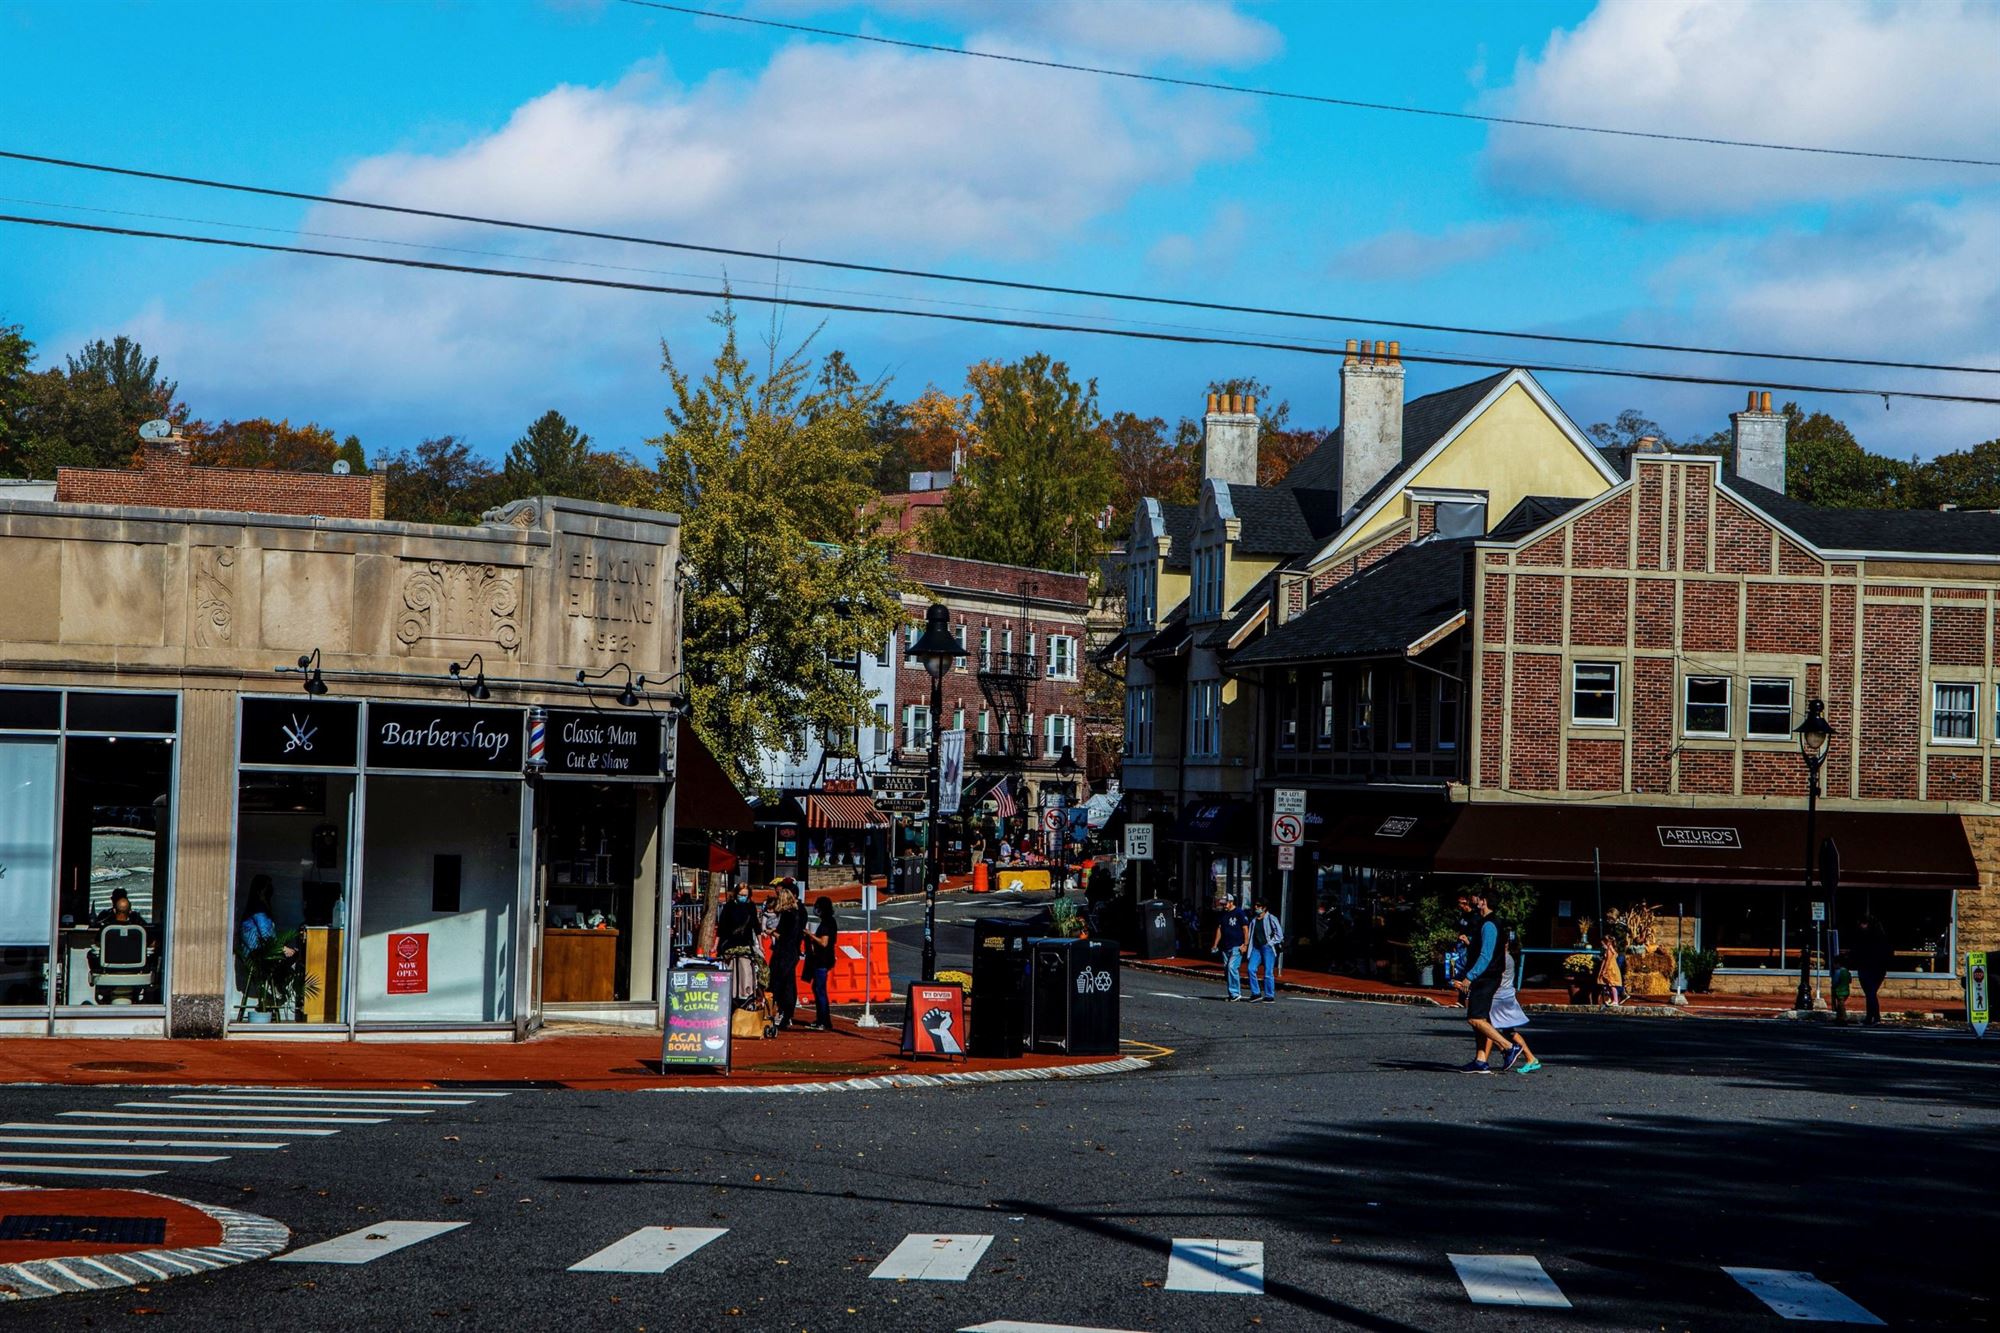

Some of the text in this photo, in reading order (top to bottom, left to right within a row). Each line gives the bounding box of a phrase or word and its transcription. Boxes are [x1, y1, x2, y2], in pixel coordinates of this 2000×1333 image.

[568, 593, 653, 624] BUILDING
[563, 718, 637, 745] Classic Man
[382, 719, 509, 760] Barbershop
[567, 750, 629, 769] Cut & Shave
[886, 777, 913, 785] BAKER
[1666, 830, 1733, 841] ARTURO'S
[1130, 842, 1147, 855] 15
[684, 991, 719, 1003] JUICE
[683, 1003, 719, 1012] CLEANSE
[669, 1015, 727, 1029] SMOOTHIES
[669, 1032, 701, 1042] ACAI
[668, 1042, 702, 1052] BOWLS
